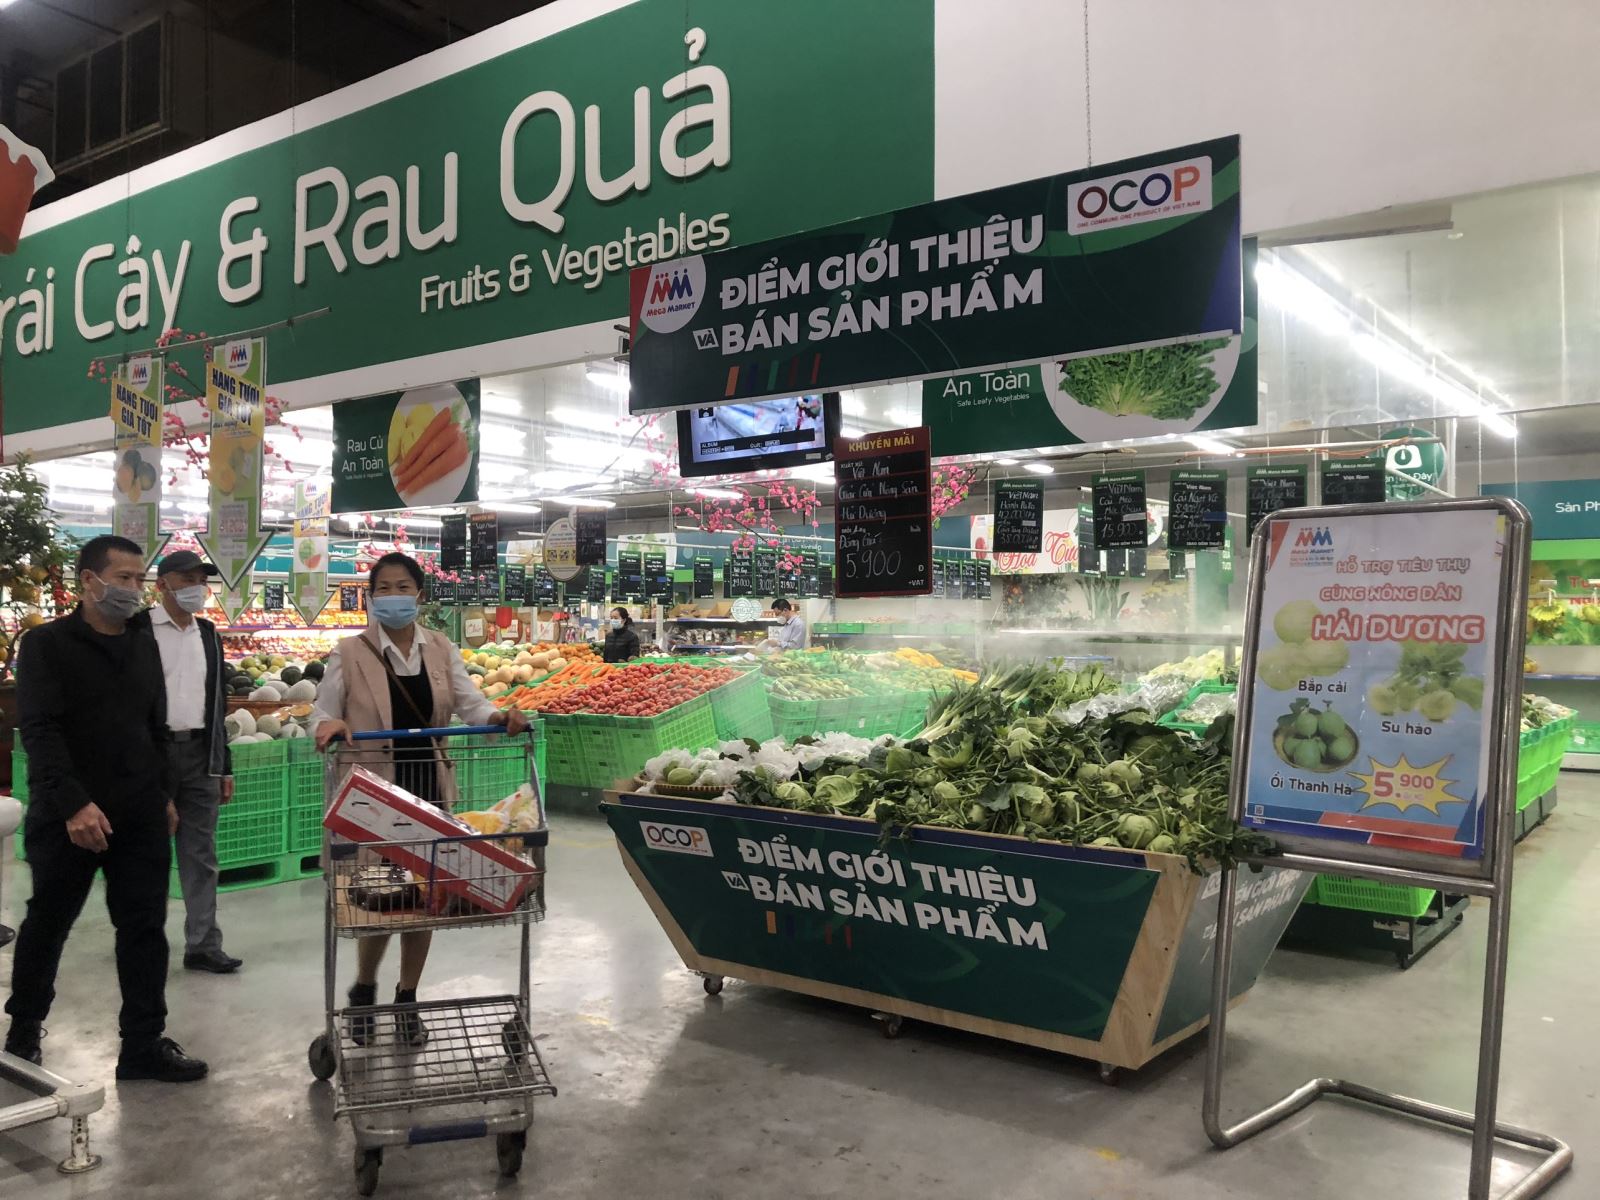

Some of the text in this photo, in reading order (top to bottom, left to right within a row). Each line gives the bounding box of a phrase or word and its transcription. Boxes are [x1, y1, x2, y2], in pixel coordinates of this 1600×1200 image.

[0, 27, 731, 355] rái Cây & Rau Quả
[1077, 166, 1200, 218] OCOP
[420, 211, 730, 313] Fruits & Vegetables
[720, 214, 1043, 309] ĐIỂM GIỚI THIỆU
[695, 265, 1043, 355] VÀ BÁN SẢN PHẨM
[942, 370, 1030, 398] An Toàn
[994, 393, 1030, 404] Vegetables
[347, 439, 367, 453] Rau
[848, 437, 891, 452] KHUYẾN
[341, 456, 384, 473] An Toàn
[1555, 502, 1581, 513] Sản
[846, 550, 901, 578] 5.900
[1362, 559, 1393, 575] TRỢ
[1397, 556, 1434, 573] TIÊU
[1436, 558, 1471, 574] THỤ
[1320, 582, 1462, 601] CÙNG NÔNG DÂN
[1312, 608, 1485, 643] HẢI DƯƠNG
[1381, 721, 1400, 733] Su
[1289, 778, 1329, 793] Thanh
[646, 825, 704, 848] OCOP
[737, 834, 1037, 907] ĐIỂM GIỚI THIỆU
[748, 873, 825, 911] BÁN
[829, 883, 908, 926] SẢN
[914, 902, 1048, 950] PHẨM
